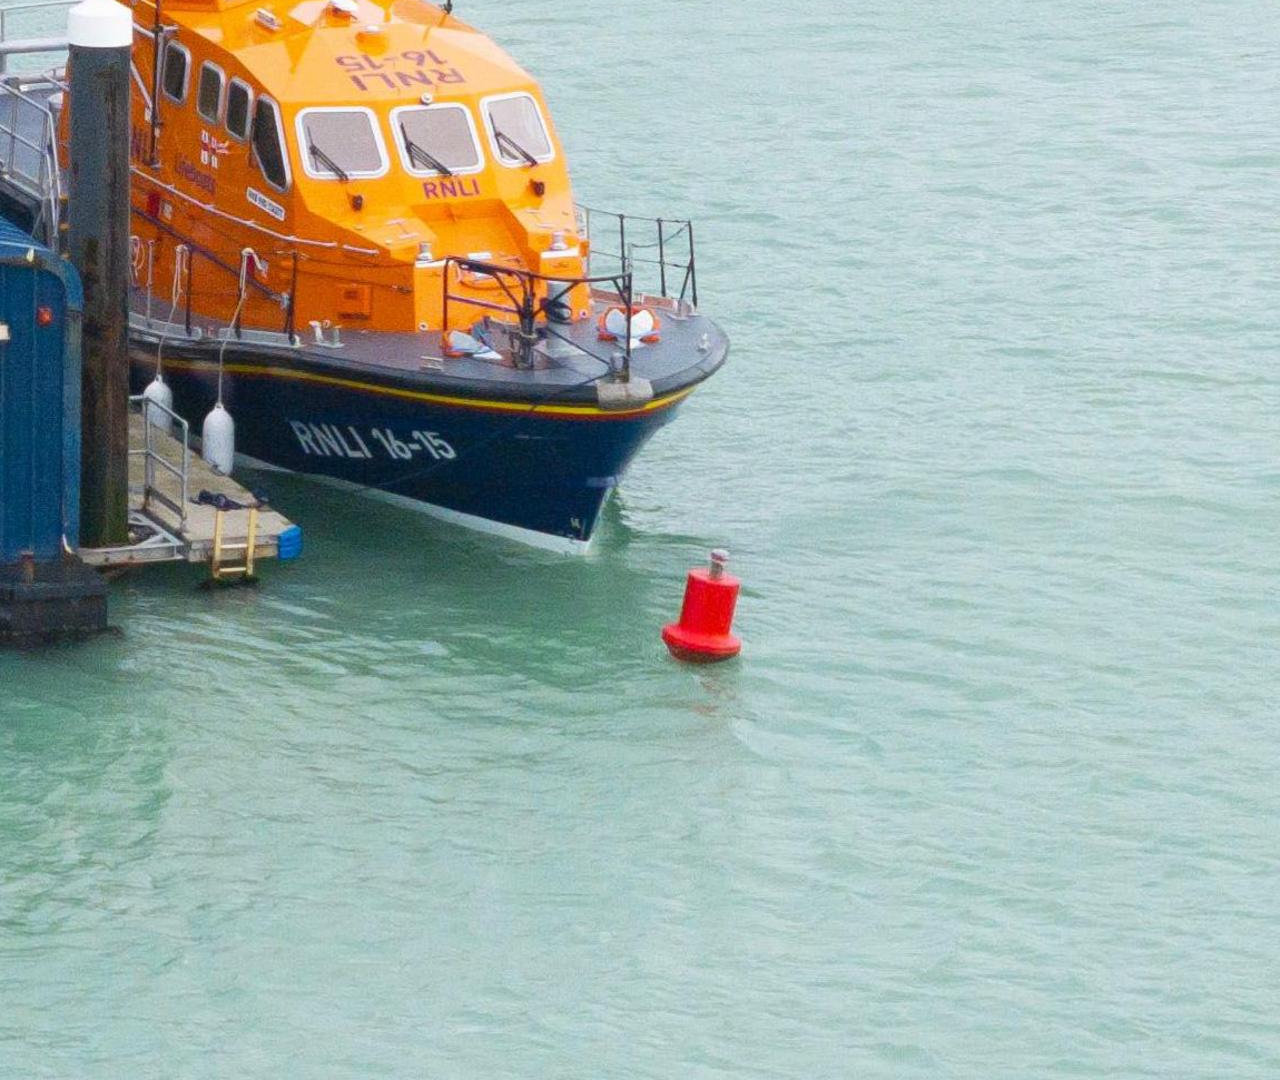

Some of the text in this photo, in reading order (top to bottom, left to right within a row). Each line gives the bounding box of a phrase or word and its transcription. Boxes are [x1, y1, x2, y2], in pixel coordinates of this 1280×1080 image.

[335, 50, 447, 73] 16-15
[350, 68, 466, 91] RNLI
[423, 178, 480, 199] RNLI
[290, 420, 457, 460] RNLI 16-15
